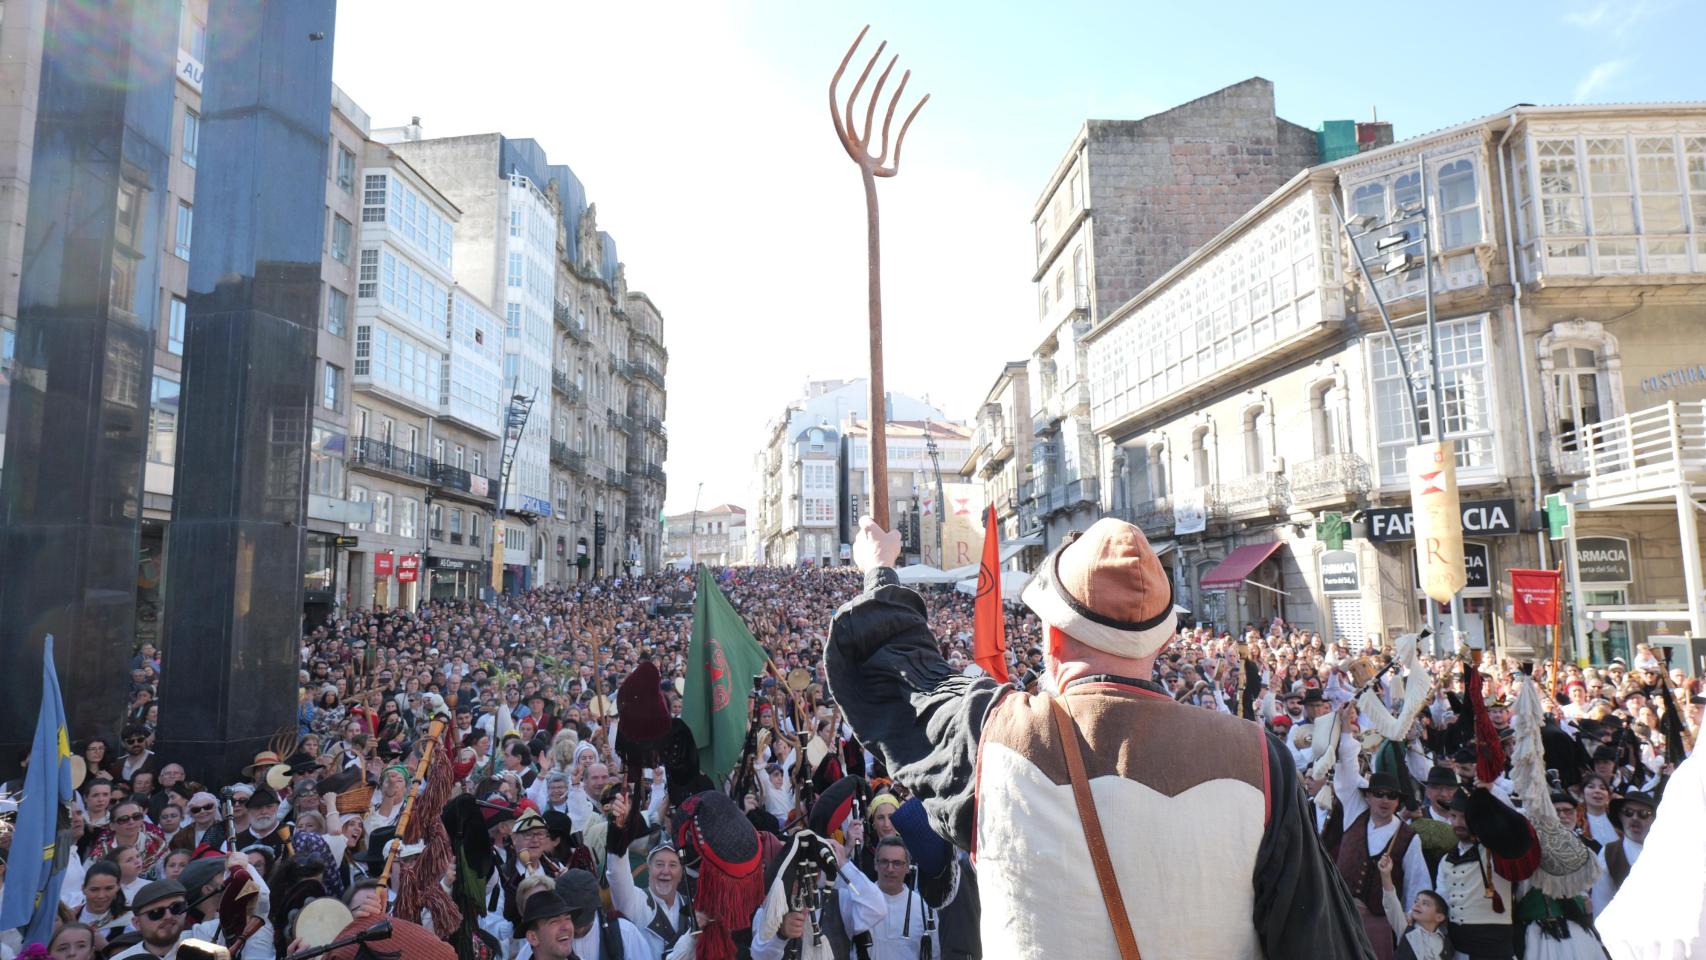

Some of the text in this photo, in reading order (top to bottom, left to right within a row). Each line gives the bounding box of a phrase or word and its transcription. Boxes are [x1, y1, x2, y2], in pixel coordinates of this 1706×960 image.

[1372, 507, 1510, 536] FARCIA
[957, 541, 970, 563] R
[1426, 537, 1449, 565] R
[1577, 550, 1626, 562] ARMACIA
